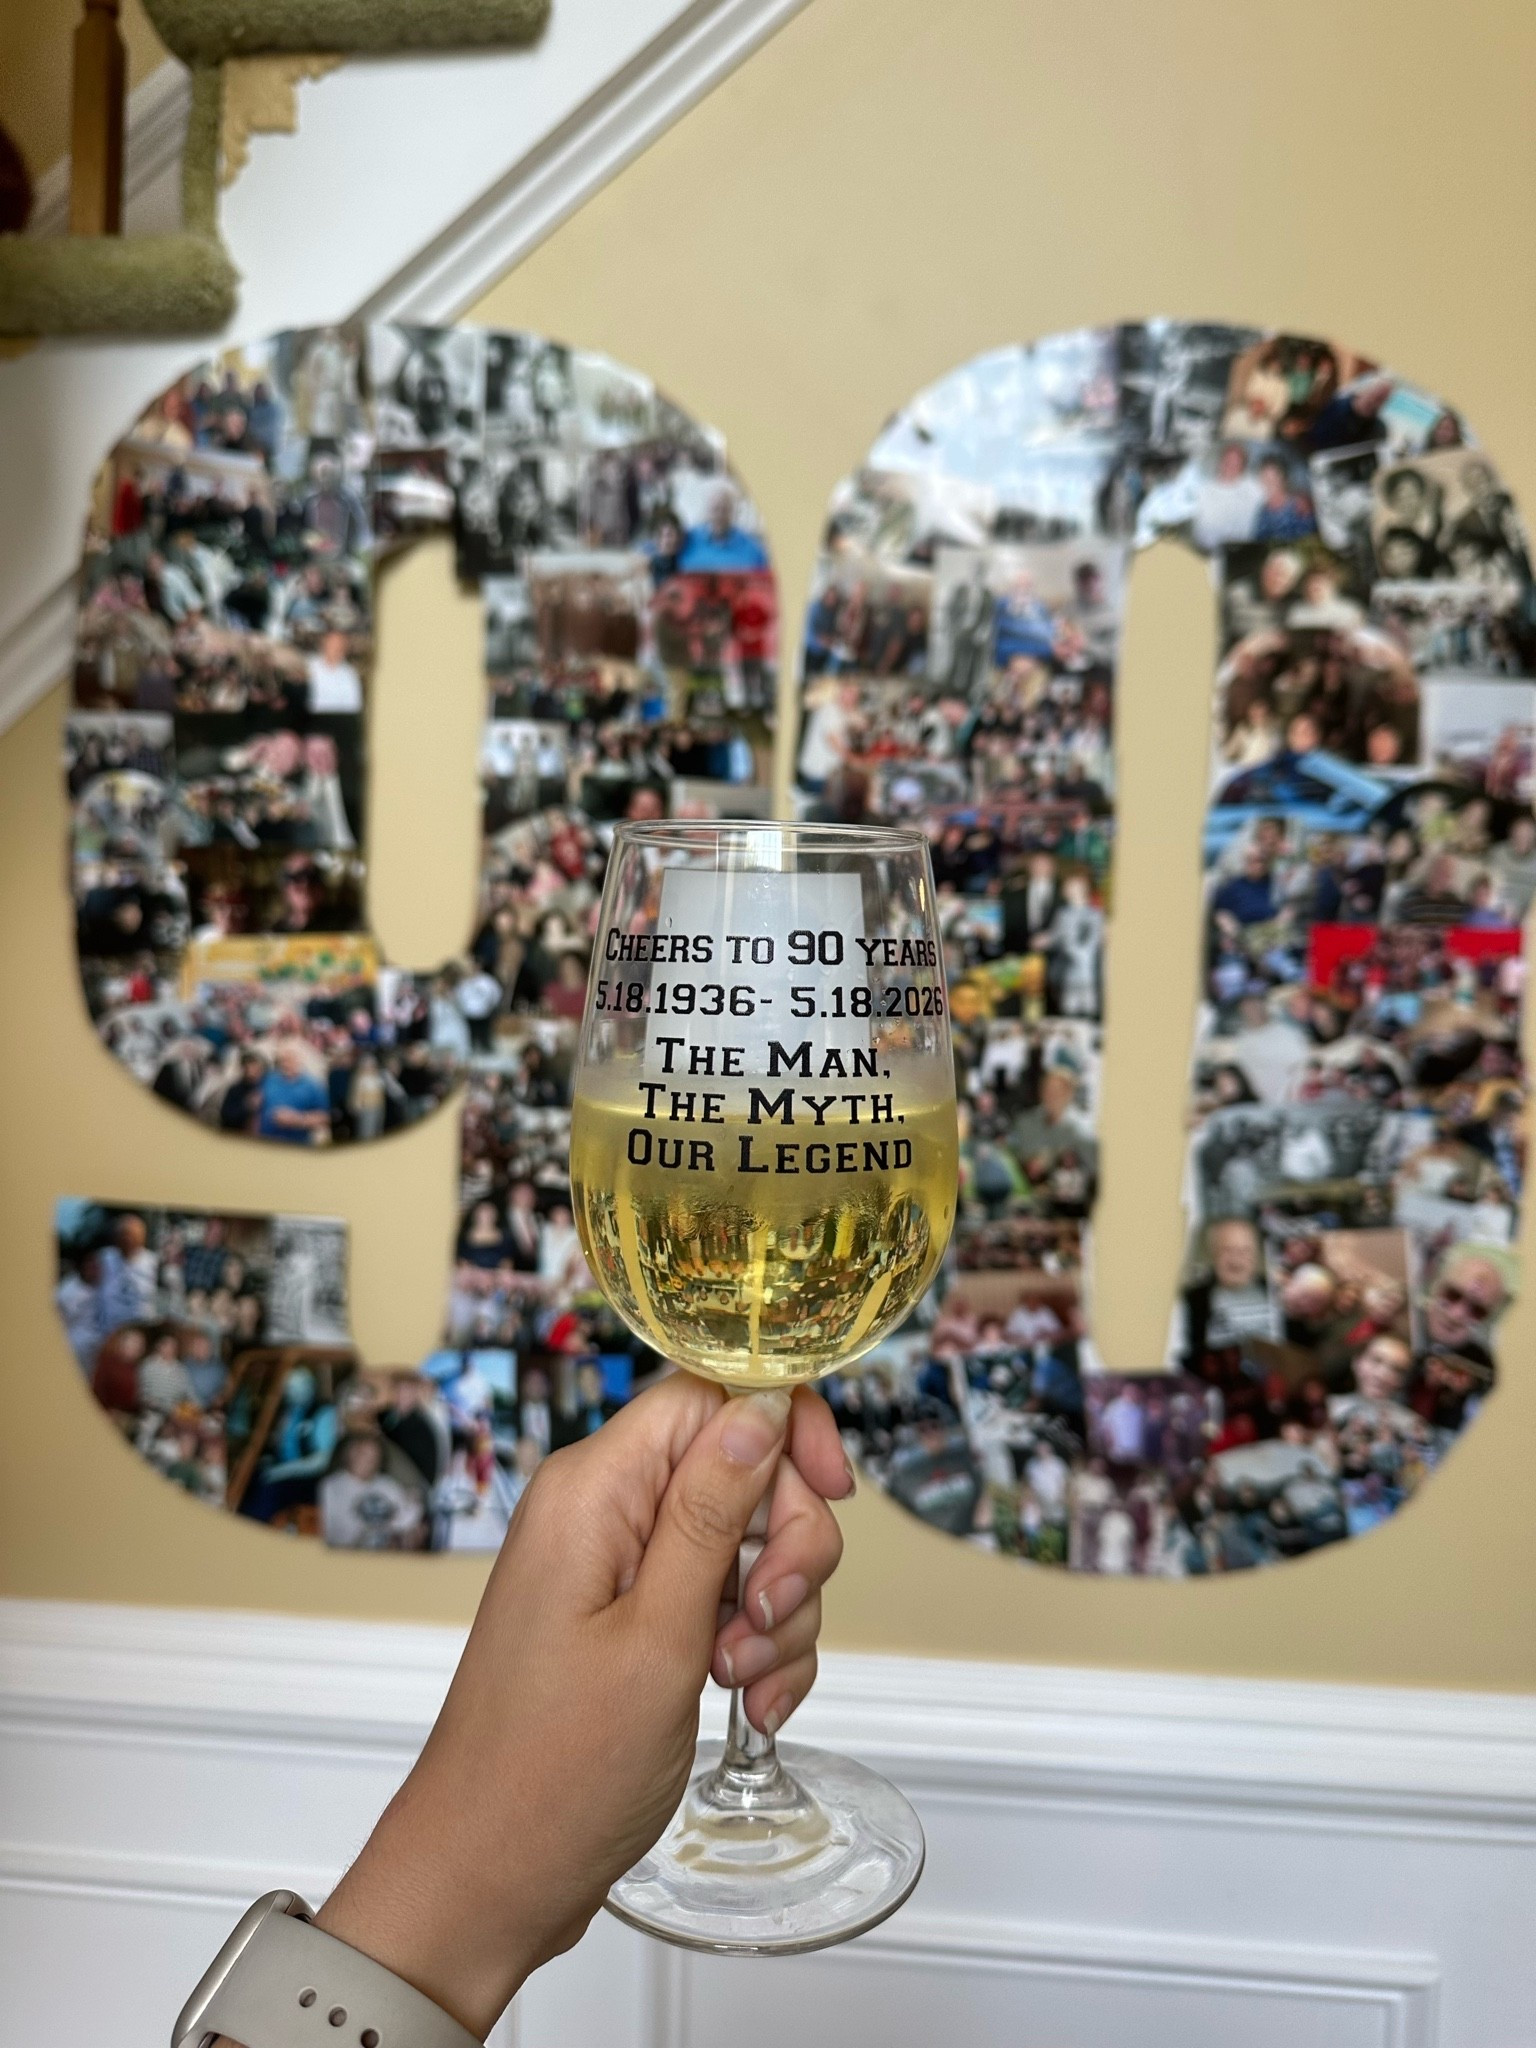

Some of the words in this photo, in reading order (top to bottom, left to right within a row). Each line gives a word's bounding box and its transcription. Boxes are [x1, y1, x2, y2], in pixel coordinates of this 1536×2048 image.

[54, 314, 1535, 1581] 90
[788, 930, 843, 965] 90
[790, 986, 943, 1018] 5.18.2026
